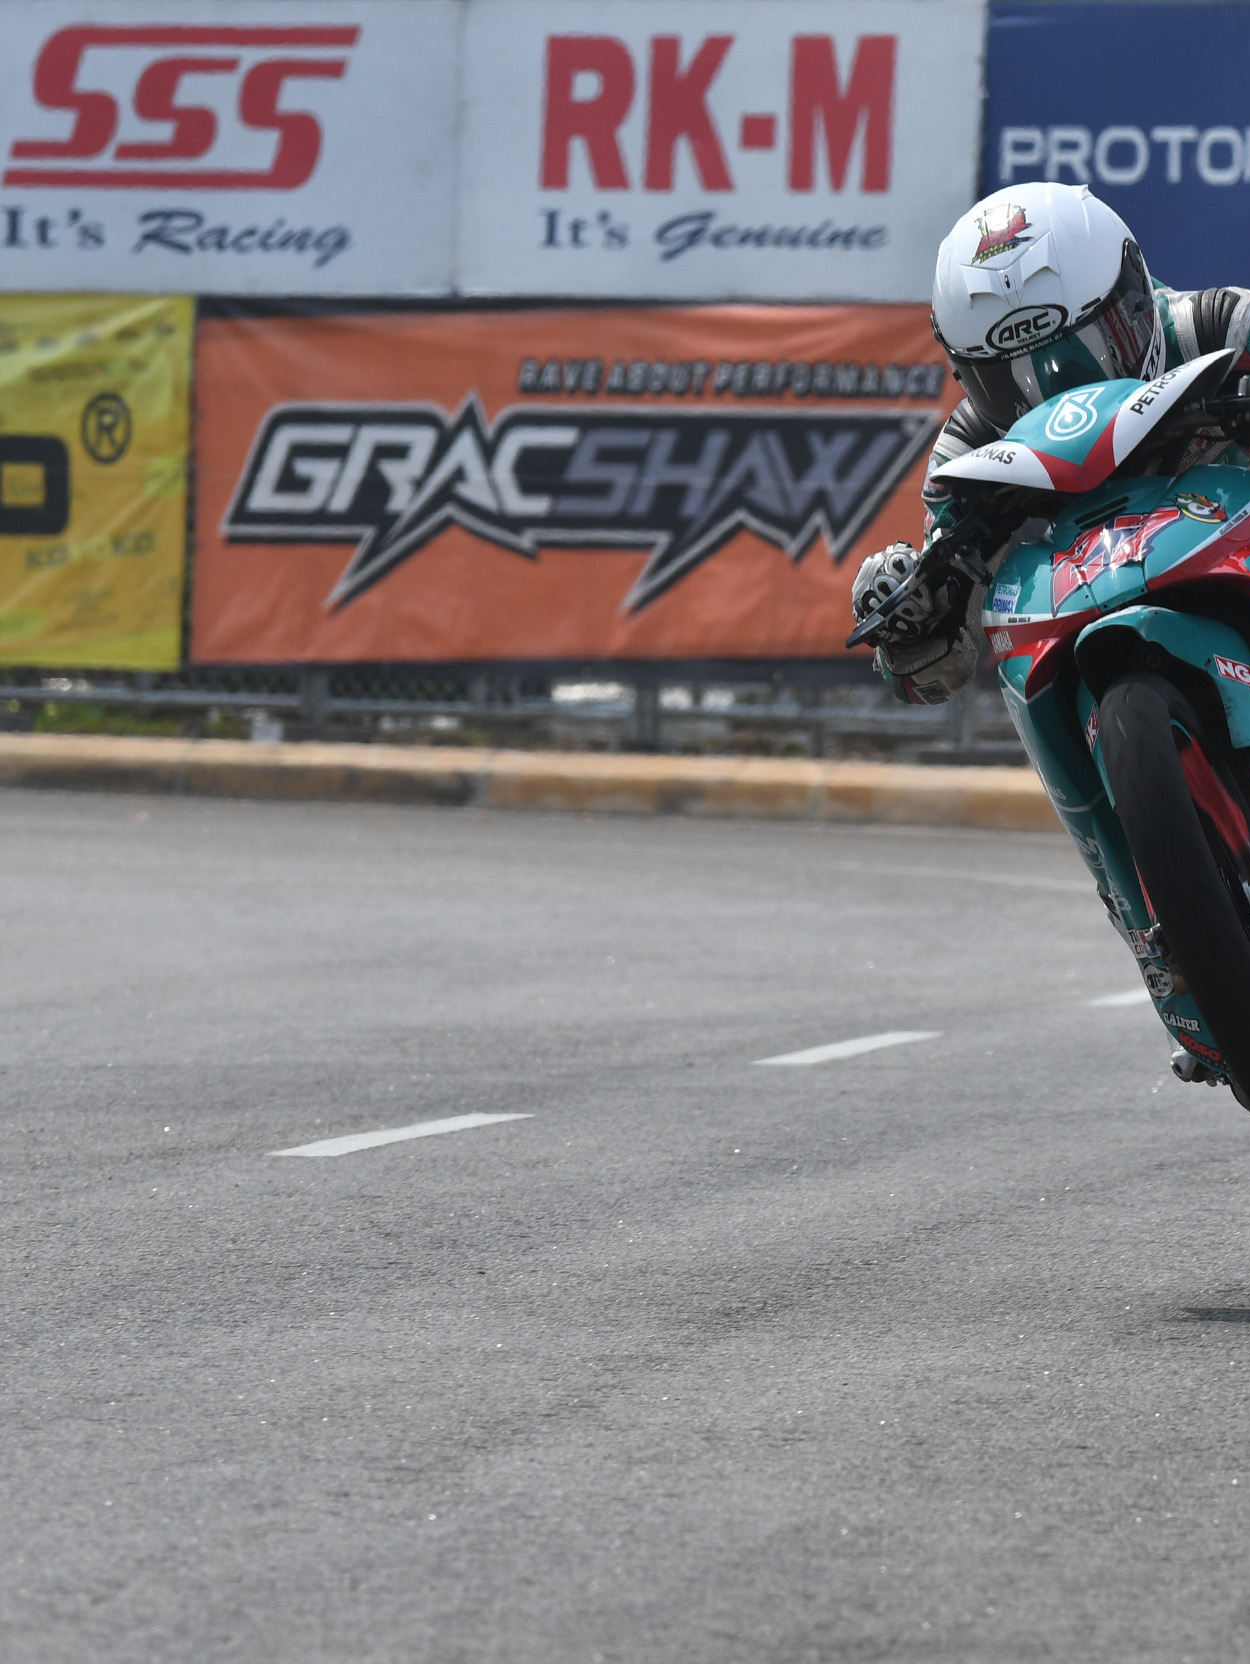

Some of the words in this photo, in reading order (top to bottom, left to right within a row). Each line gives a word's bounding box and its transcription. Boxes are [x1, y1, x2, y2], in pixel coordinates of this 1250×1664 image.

[2, 23, 362, 191] SSS
[538, 34, 899, 193] RK-M
[3, 206, 105, 250] It's
[132, 208, 352, 269] Racing
[540, 208, 628, 251] It's
[653, 209, 891, 263] Genuine
[998, 310, 1051, 345] ARC
[519, 358, 598, 395] RAVE
[606, 360, 708, 396] ABOUT
[713, 362, 945, 398] PERFORMANCE
[225, 395, 935, 575] GRACSHAW
